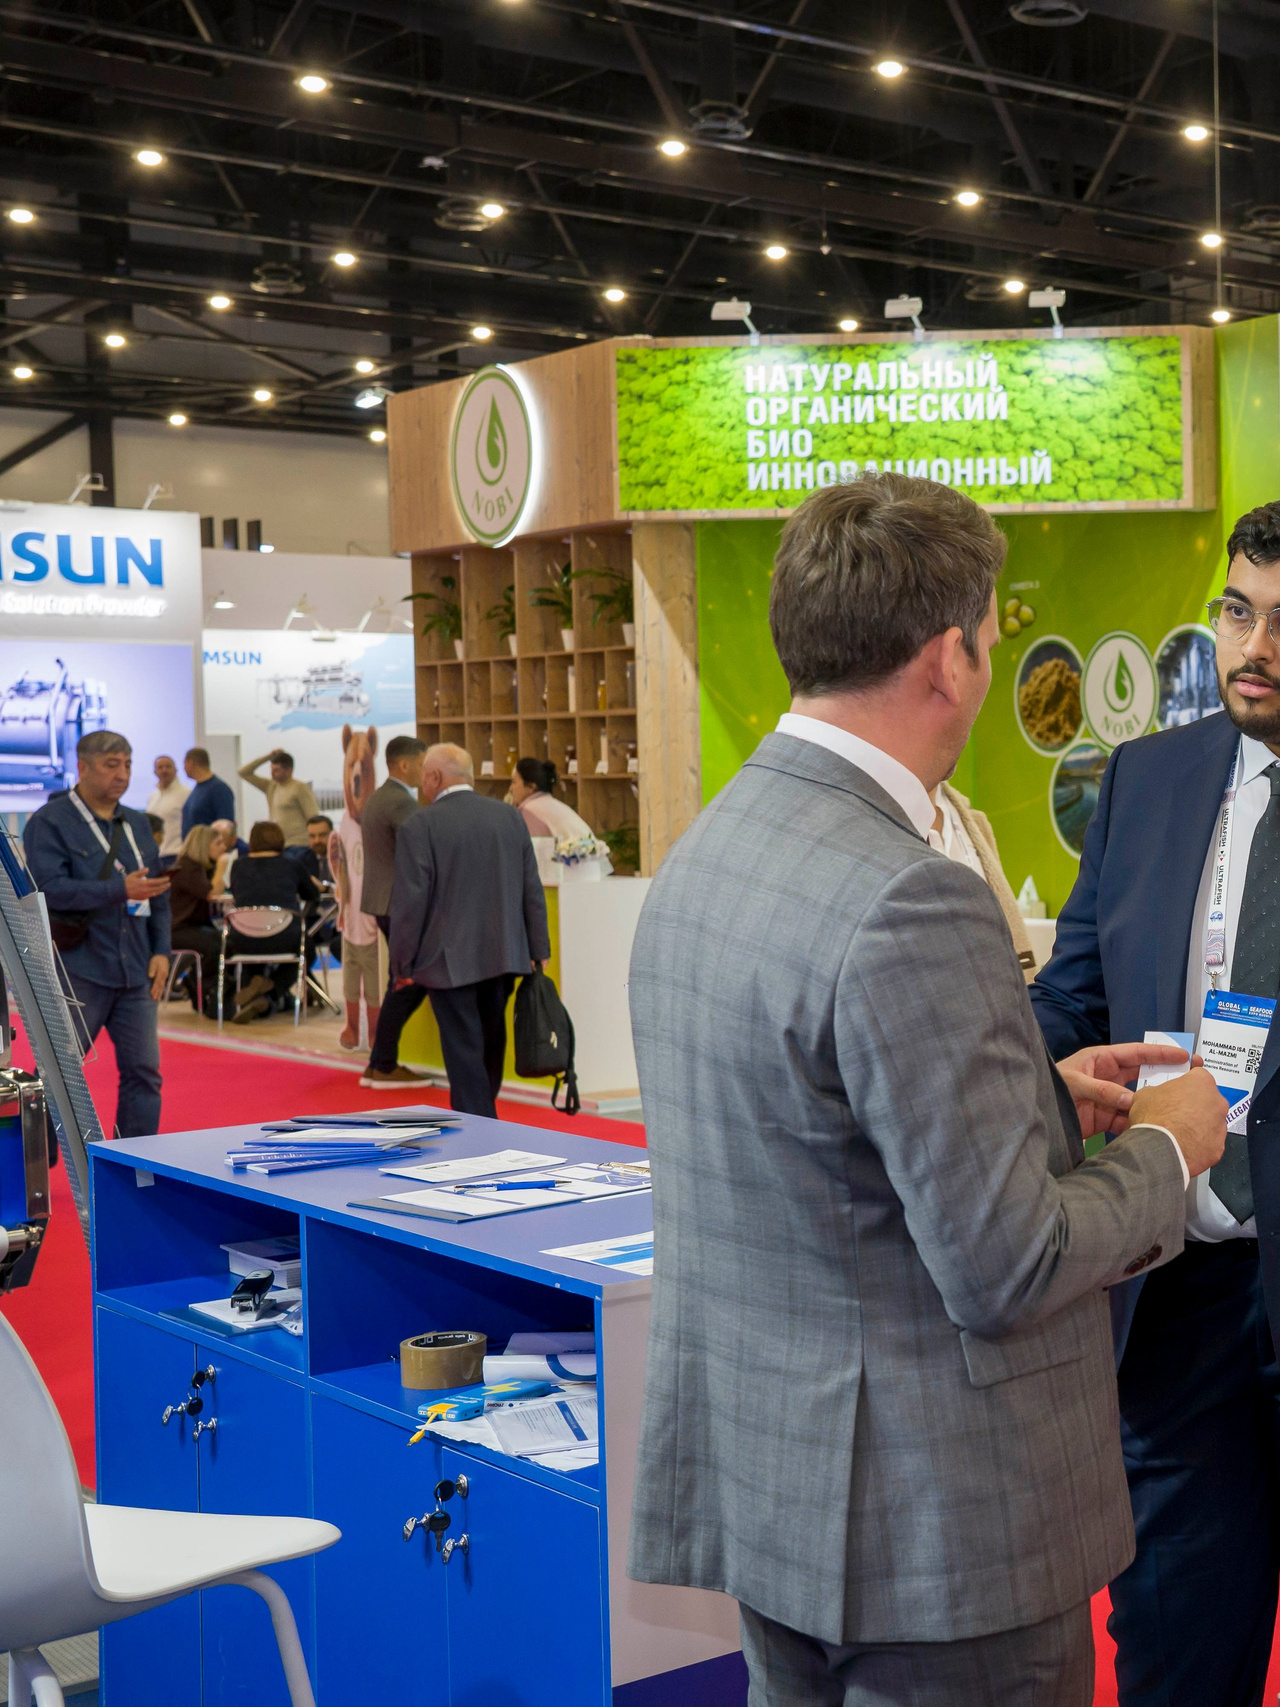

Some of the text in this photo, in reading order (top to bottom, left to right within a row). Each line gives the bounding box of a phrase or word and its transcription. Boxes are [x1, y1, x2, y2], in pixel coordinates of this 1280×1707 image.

[745, 352, 998, 393] НАТУРАЛЬНЫЙ
[746, 385, 1008, 426] ОРГАНИЧЕСКИЙ
[747, 429, 813, 458] БИО
[471, 487, 514, 521] NOBI
[0, 531, 164, 587] SUN
[203, 650, 262, 665] MSUN
[1102, 714, 1141, 737] NOBI
[1221, 808, 1230, 848] ULTRAFISH
[1215, 865, 1225, 906] ULTRAFISH
[1218, 1001, 1241, 1010] GLOBAL
[1249, 1006, 1273, 1015] SEAFOOD
[1202, 1040, 1236, 1051] MOHAMMAD
[1209, 1049, 1237, 1058] AL-MAZMI
[1204, 1058, 1233, 1067] Administration
